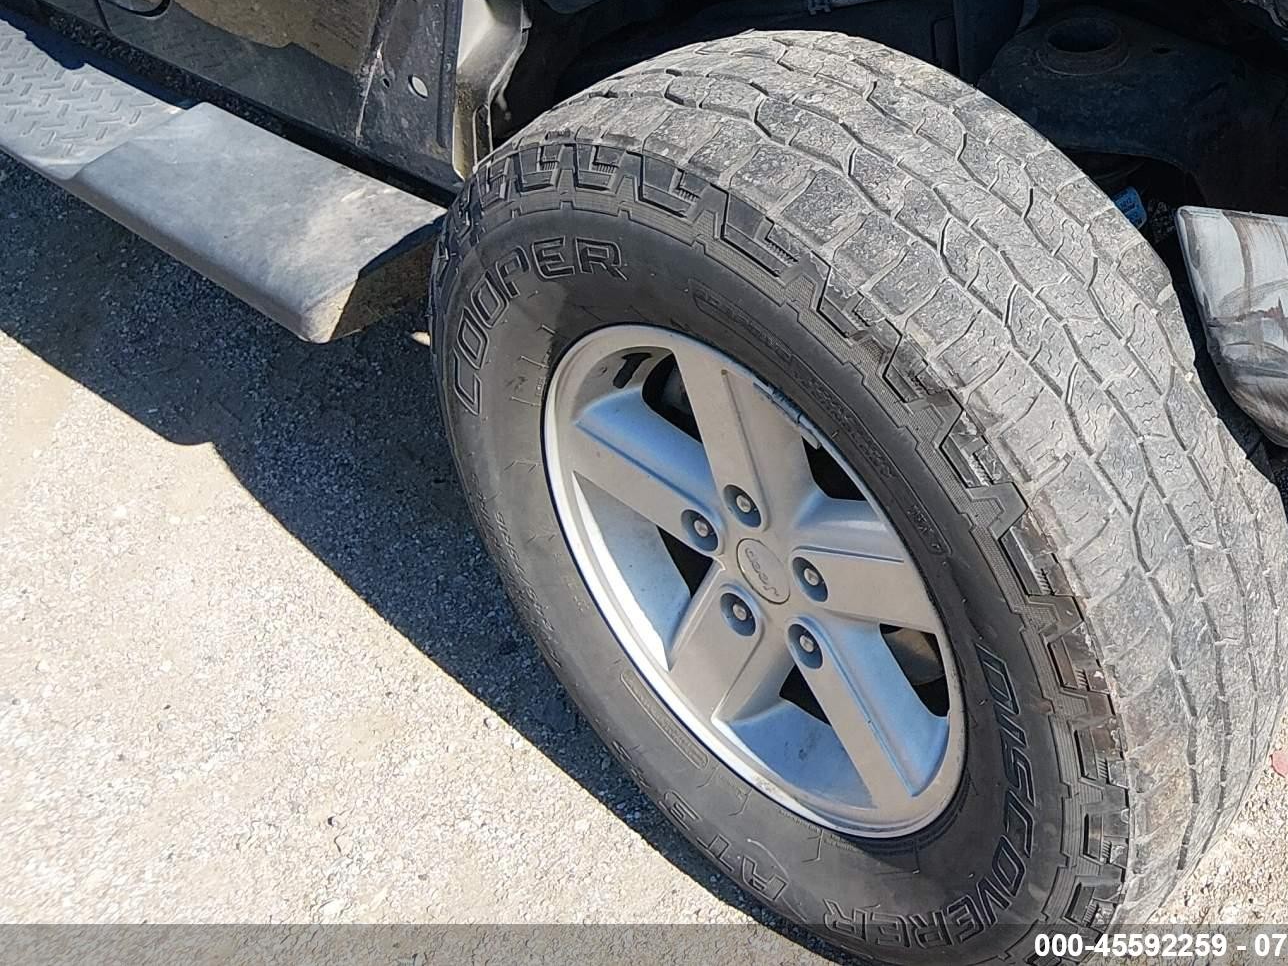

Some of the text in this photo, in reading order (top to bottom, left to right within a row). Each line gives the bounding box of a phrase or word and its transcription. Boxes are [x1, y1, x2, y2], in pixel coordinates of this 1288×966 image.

[452, 236, 629, 416] COOPER
[744, 547, 780, 598] Jeep
[822, 642, 1037, 950] DISCOVERER
